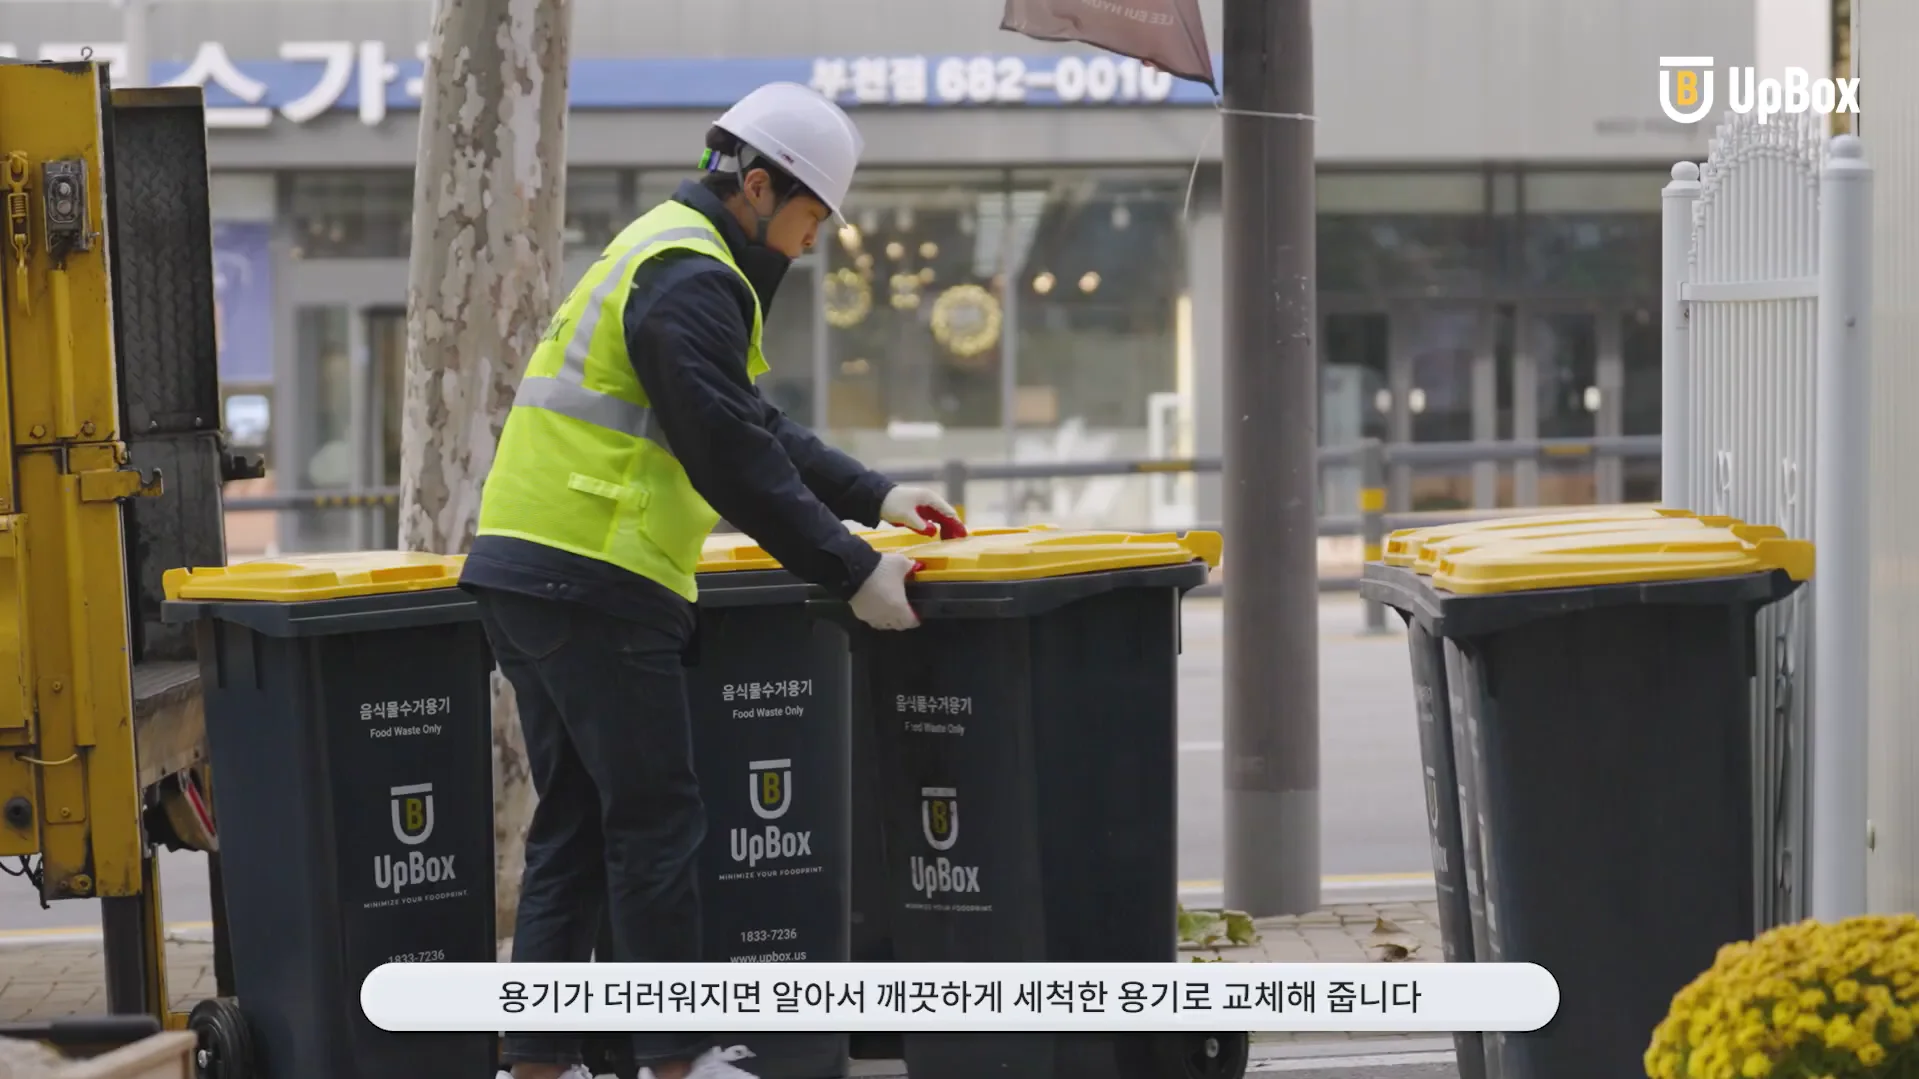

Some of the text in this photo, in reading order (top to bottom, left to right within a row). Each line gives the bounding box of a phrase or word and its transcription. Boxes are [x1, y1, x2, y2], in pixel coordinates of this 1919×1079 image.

[810, 57, 1173, 103] 부천점 682-0010
[722, 679, 813, 701] 음식물수거용기
[359, 696, 450, 720] 음식물수거용기
[732, 705, 804, 719] Food Waste Only
[370, 724, 442, 739] Food Waste Only
[731, 825, 812, 867] UpBox
[374, 851, 456, 894] UpBox
[719, 872, 755, 881] MINIMIZE
[757, 869, 778, 878] YOUR
[910, 856, 980, 899] UpBox
[363, 899, 399, 909] MINIMIZE
[402, 896, 423, 904] YOUR
[740, 928, 797, 942] 1833-7236
[387, 949, 445, 963] 1833-7236
[730, 950, 807, 963] www.upbox.us
